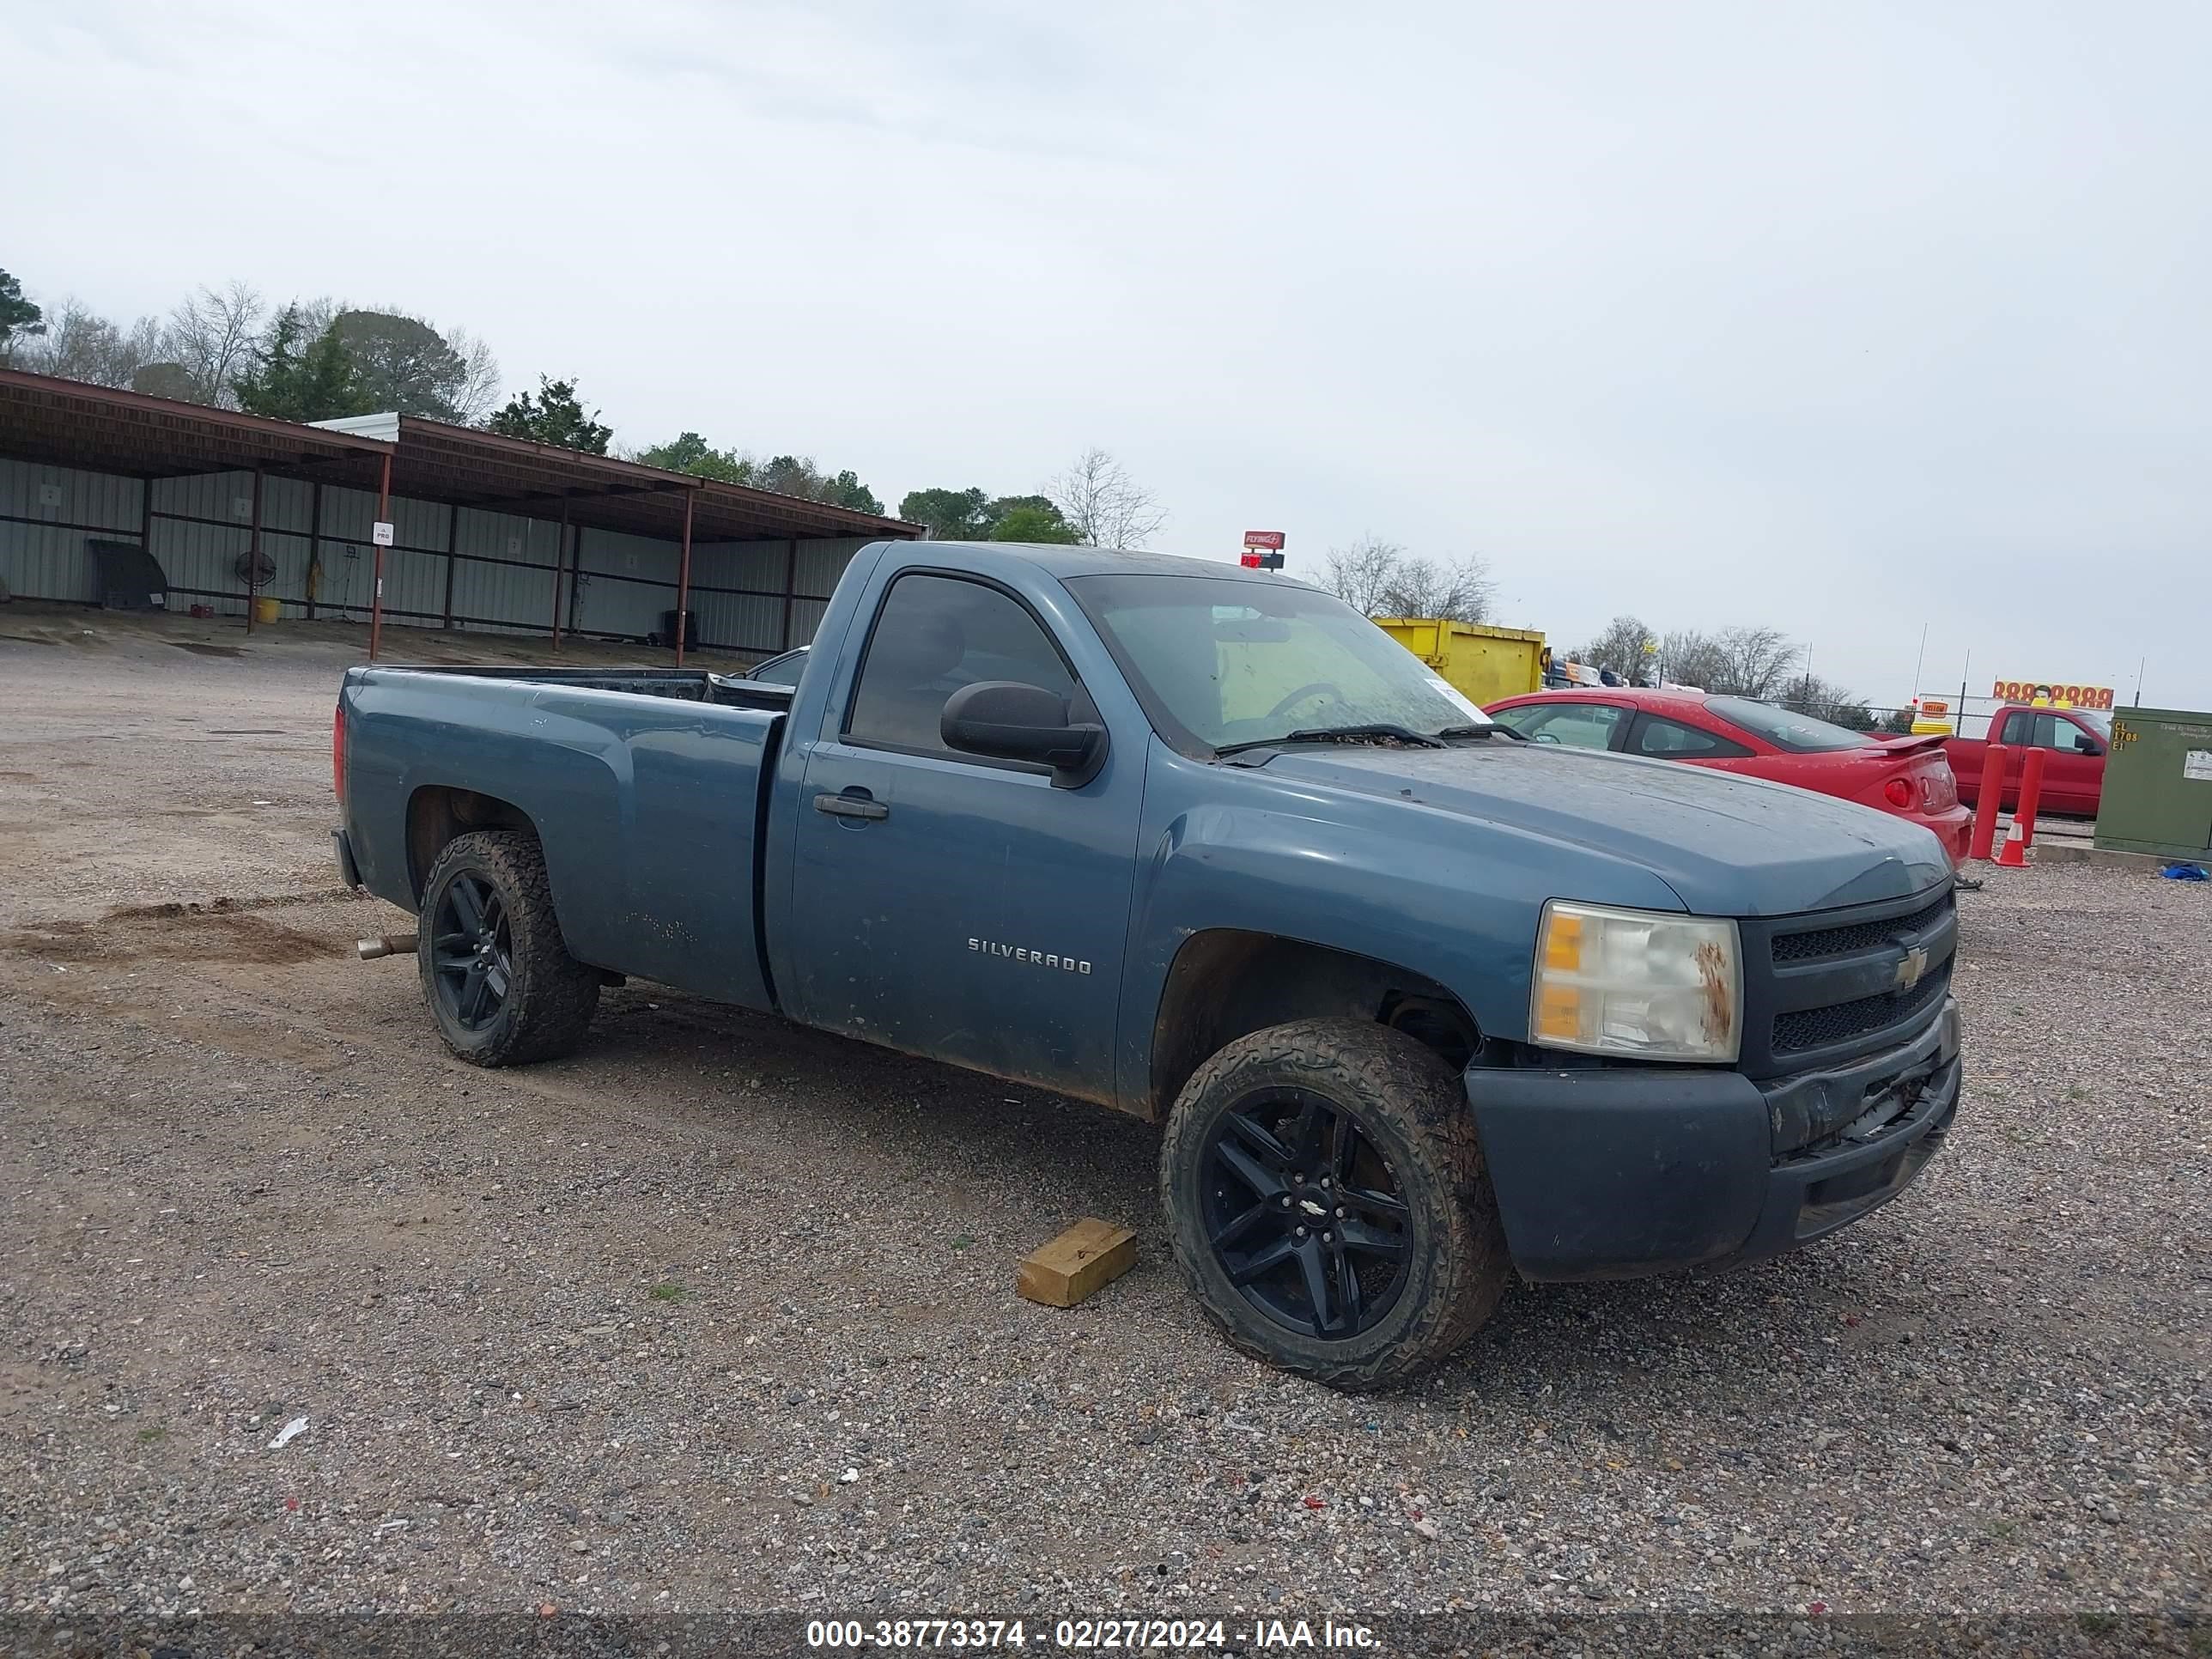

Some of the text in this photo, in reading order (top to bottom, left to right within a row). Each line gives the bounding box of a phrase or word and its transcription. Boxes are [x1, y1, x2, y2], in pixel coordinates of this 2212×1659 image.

[1246, 535, 1272, 544] FLYING
[2115, 722, 2126, 731] CL
[2114, 732, 2137, 742] 1708
[2112, 742, 2124, 750] E1
[968, 938, 1091, 975] SILVERADO
